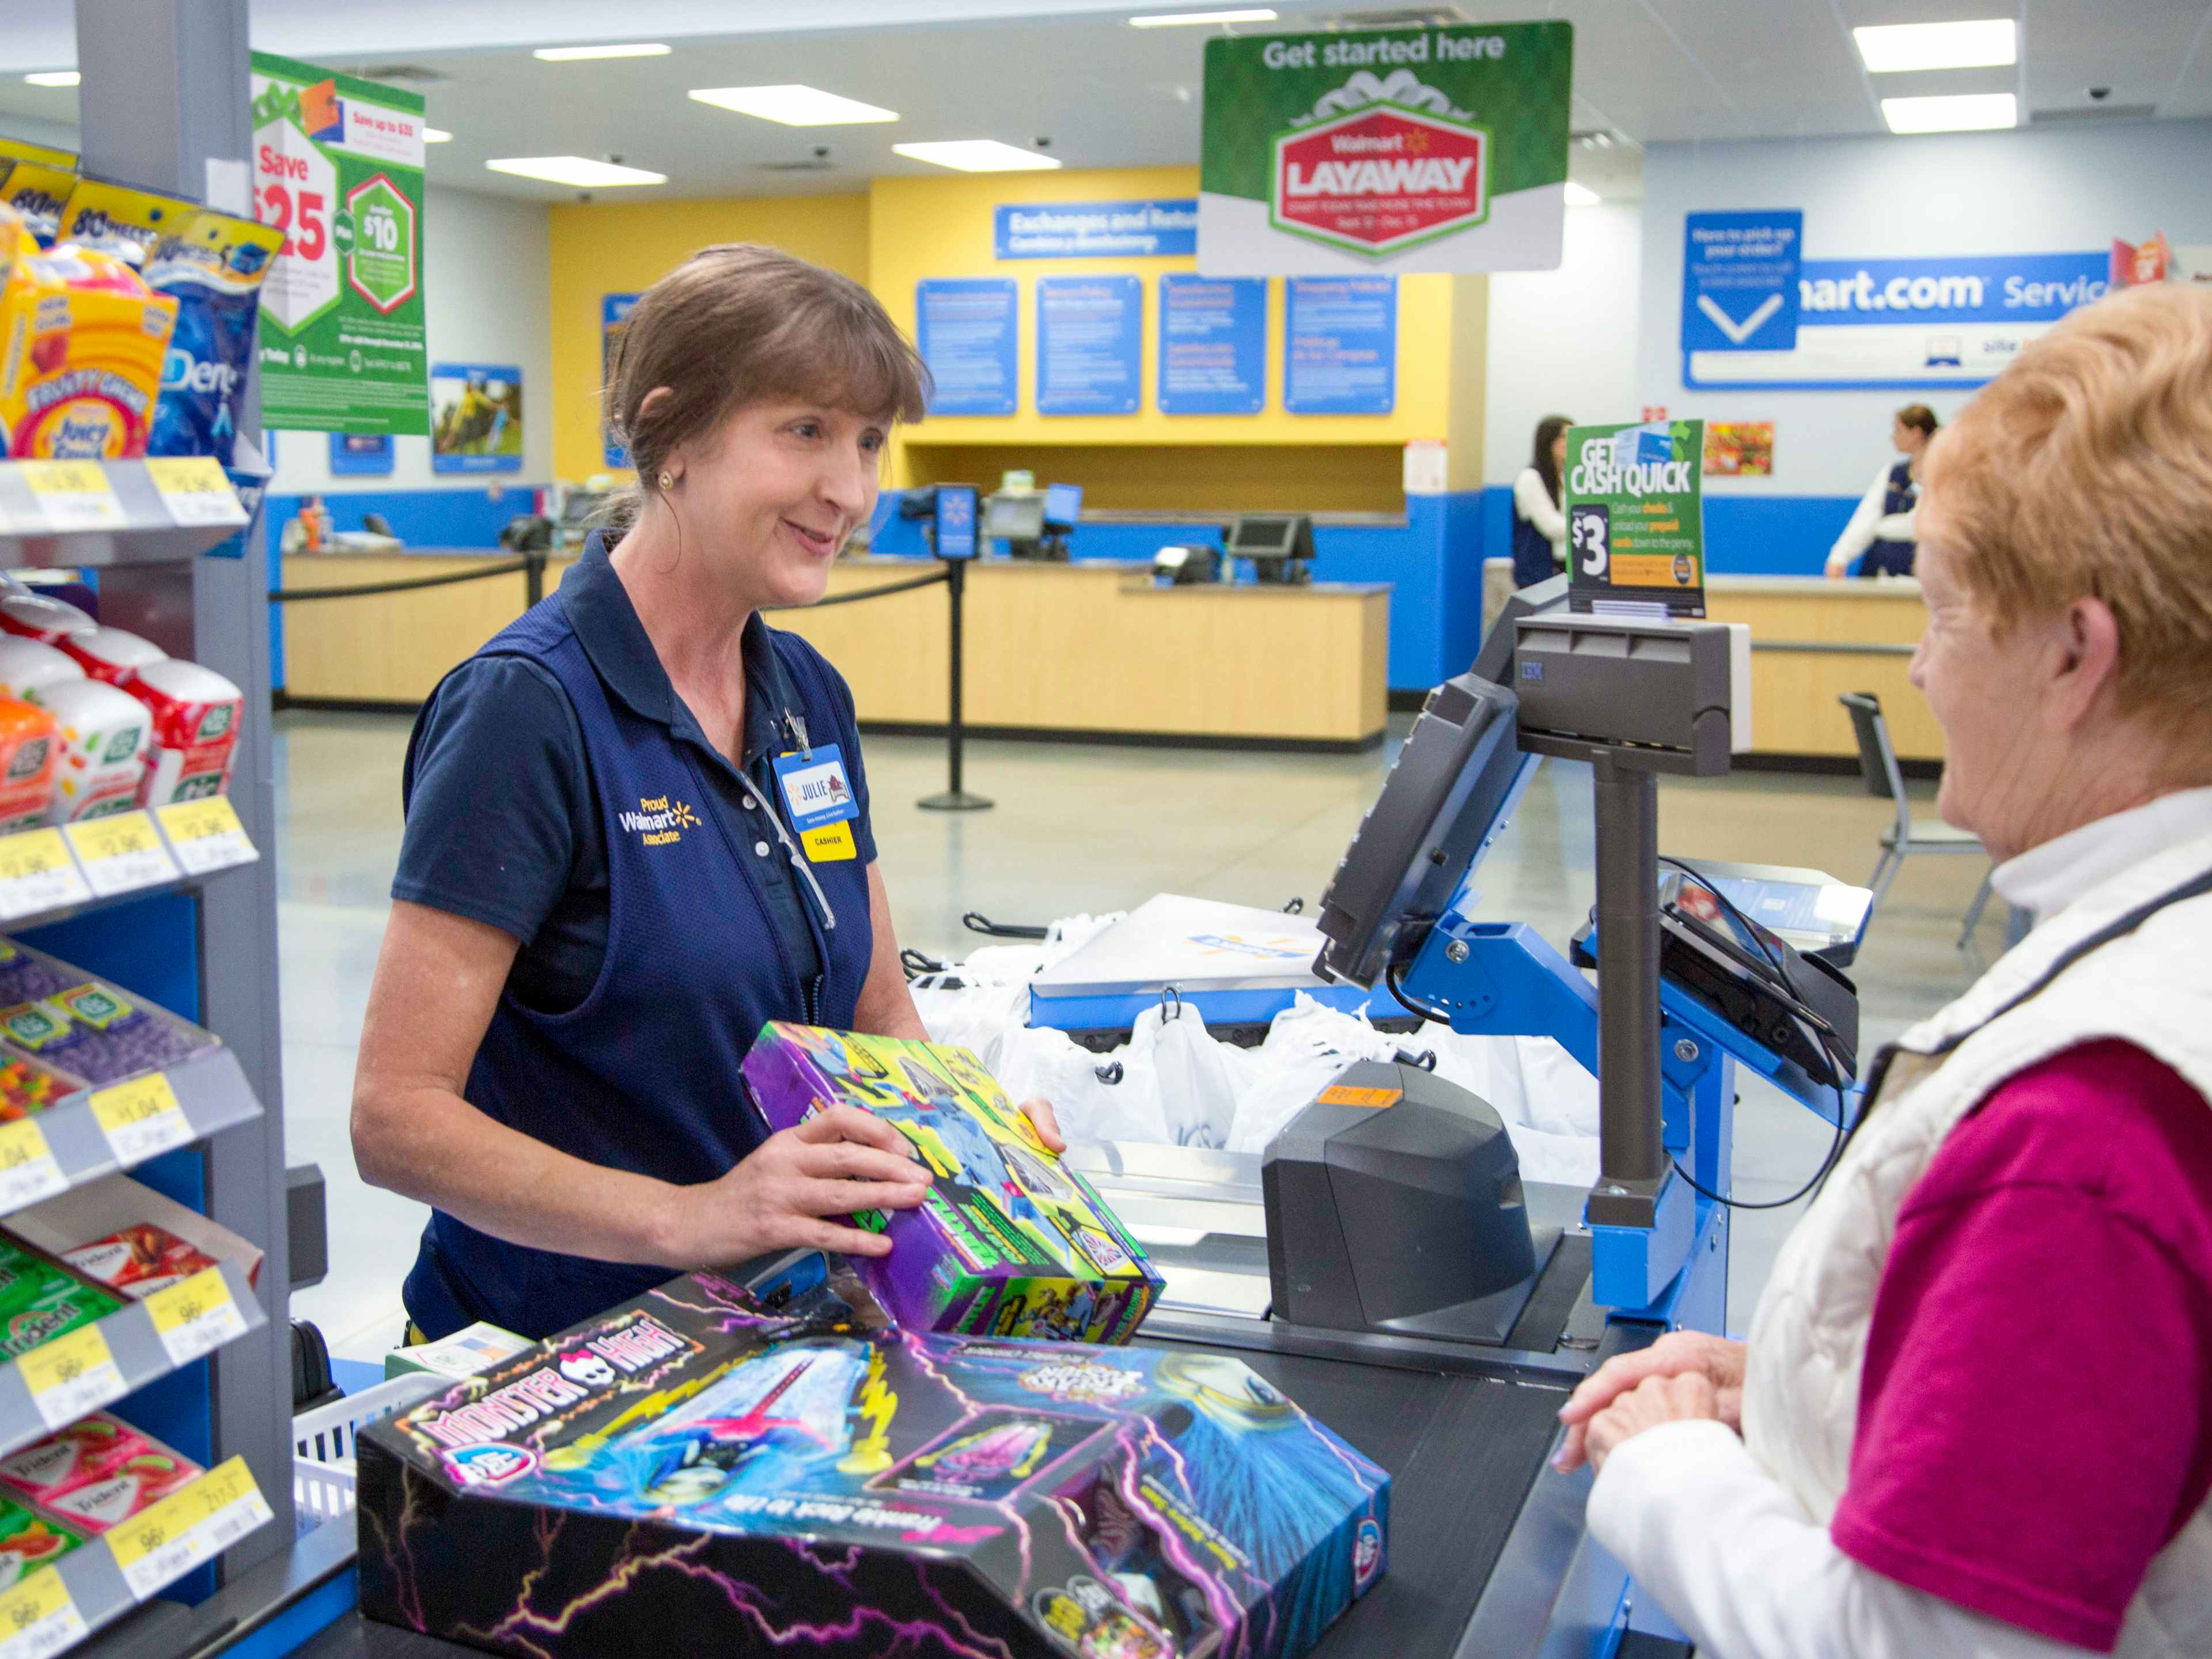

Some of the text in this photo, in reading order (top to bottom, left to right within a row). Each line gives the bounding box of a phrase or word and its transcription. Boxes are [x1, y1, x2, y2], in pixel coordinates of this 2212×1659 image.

[1264, 33, 1506, 69] Get started here
[1331, 133, 1403, 153] Walmart
[260, 144, 308, 181] Save
[1287, 157, 1475, 196] LAYAWAY
[363, 214, 398, 252] $10
[1582, 438, 1619, 469] GET
[1571, 461, 1691, 498] CASH QUICK
[1571, 514, 1607, 576] $3
[1521, 661, 1544, 681] IBM
[639, 795, 669, 812] Proud
[801, 780, 828, 801] JULIE
[619, 810, 676, 833] Walmart
[642, 830, 681, 845] Associate
[815, 836, 842, 846] CASHIER
[417, 1317, 685, 1447] MONSTER HIGH
[77, 1480, 131, 1513] Trident
